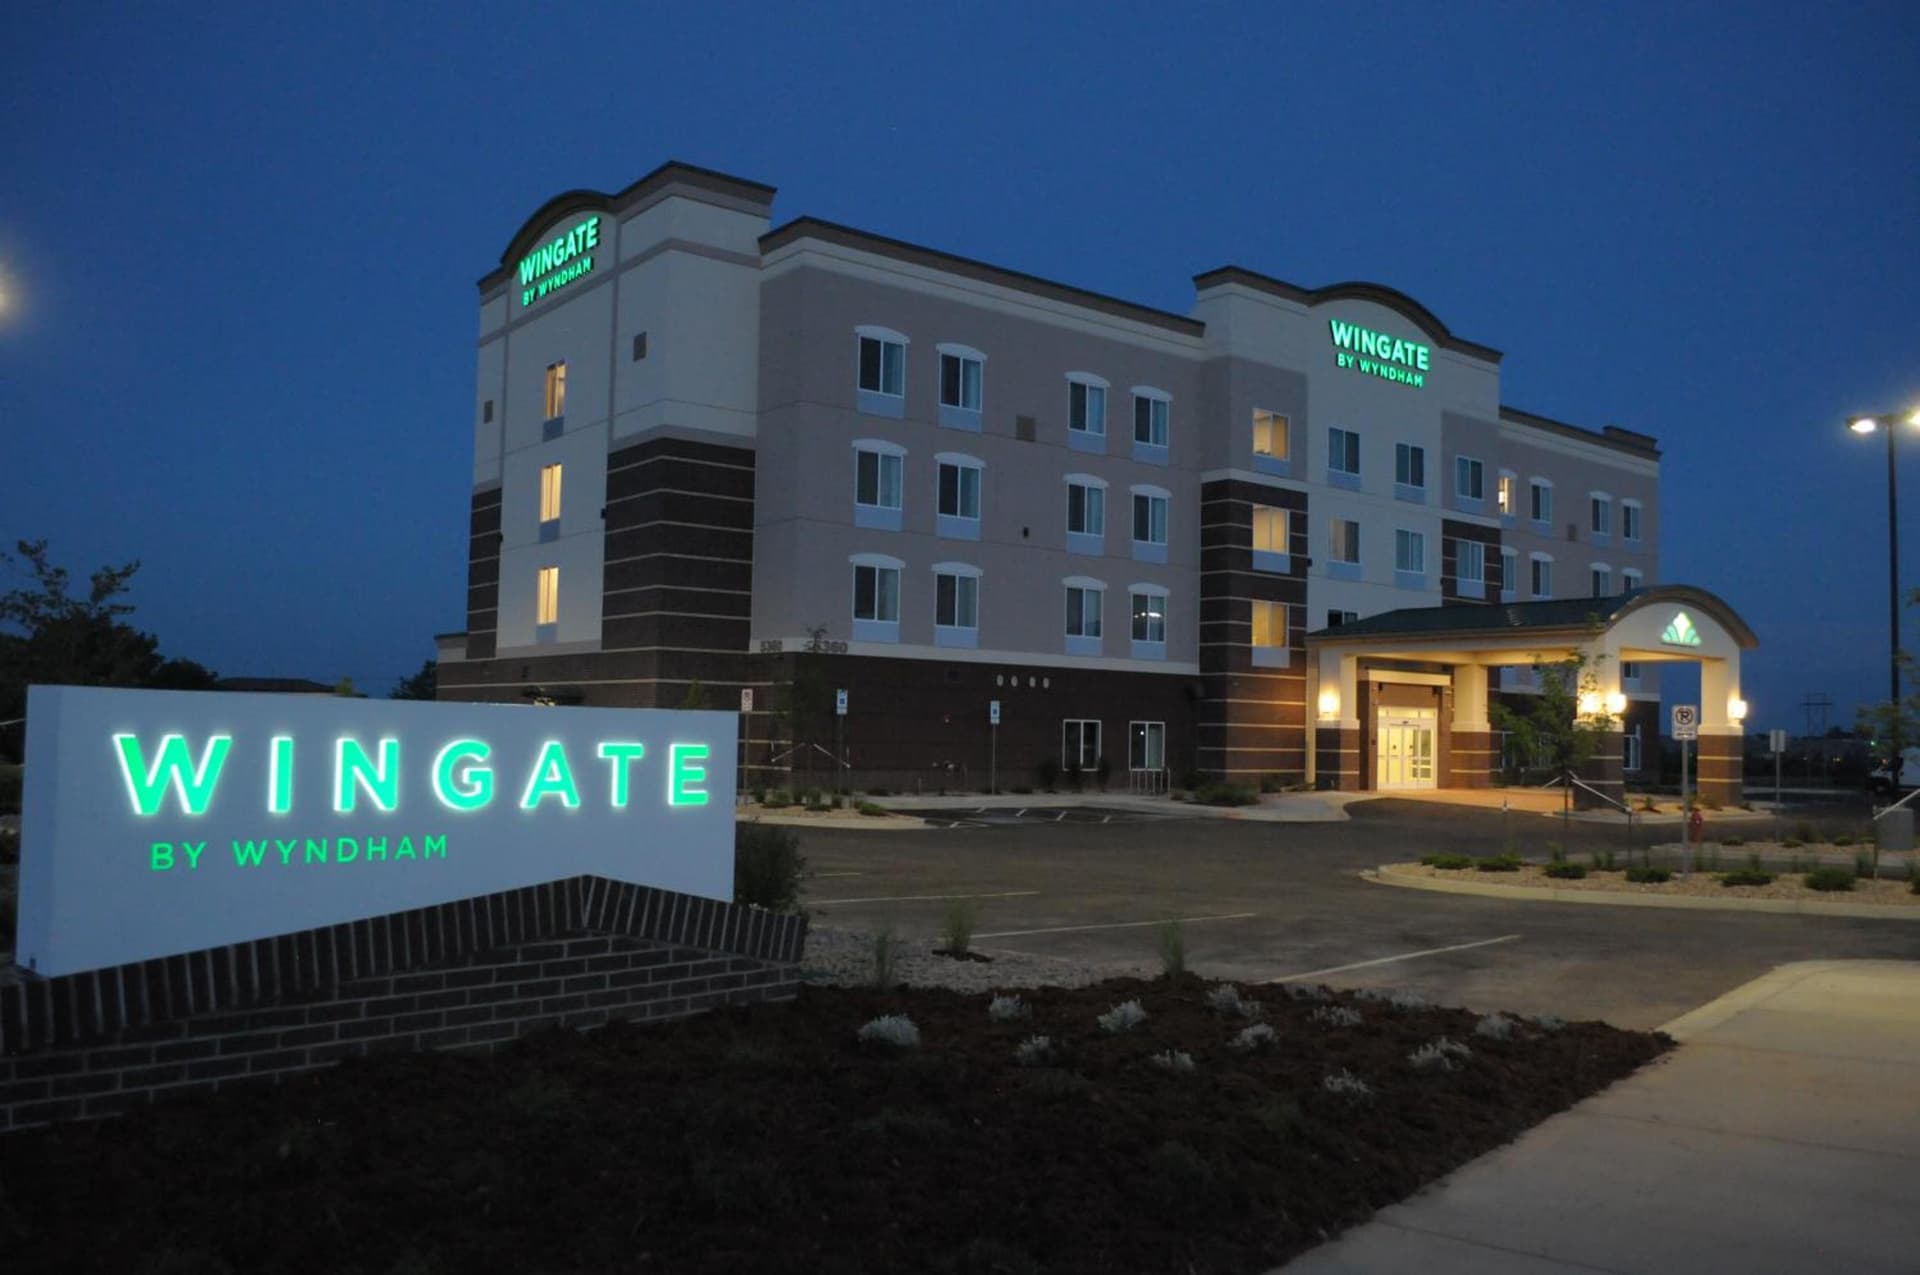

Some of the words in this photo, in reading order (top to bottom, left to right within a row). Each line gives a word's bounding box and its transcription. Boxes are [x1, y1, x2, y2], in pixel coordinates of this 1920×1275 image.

[519, 216, 599, 286] WINGATE
[522, 287, 536, 306] BY
[538, 256, 592, 297] WYNDHAM
[1330, 318, 1430, 371] WINGATE
[1337, 352, 1354, 368] BY
[1359, 358, 1424, 388] WYNDHAM
[112, 732, 711, 816] WINGATE
[150, 841, 207, 871] BY
[232, 833, 448, 868] WYNDHAM
